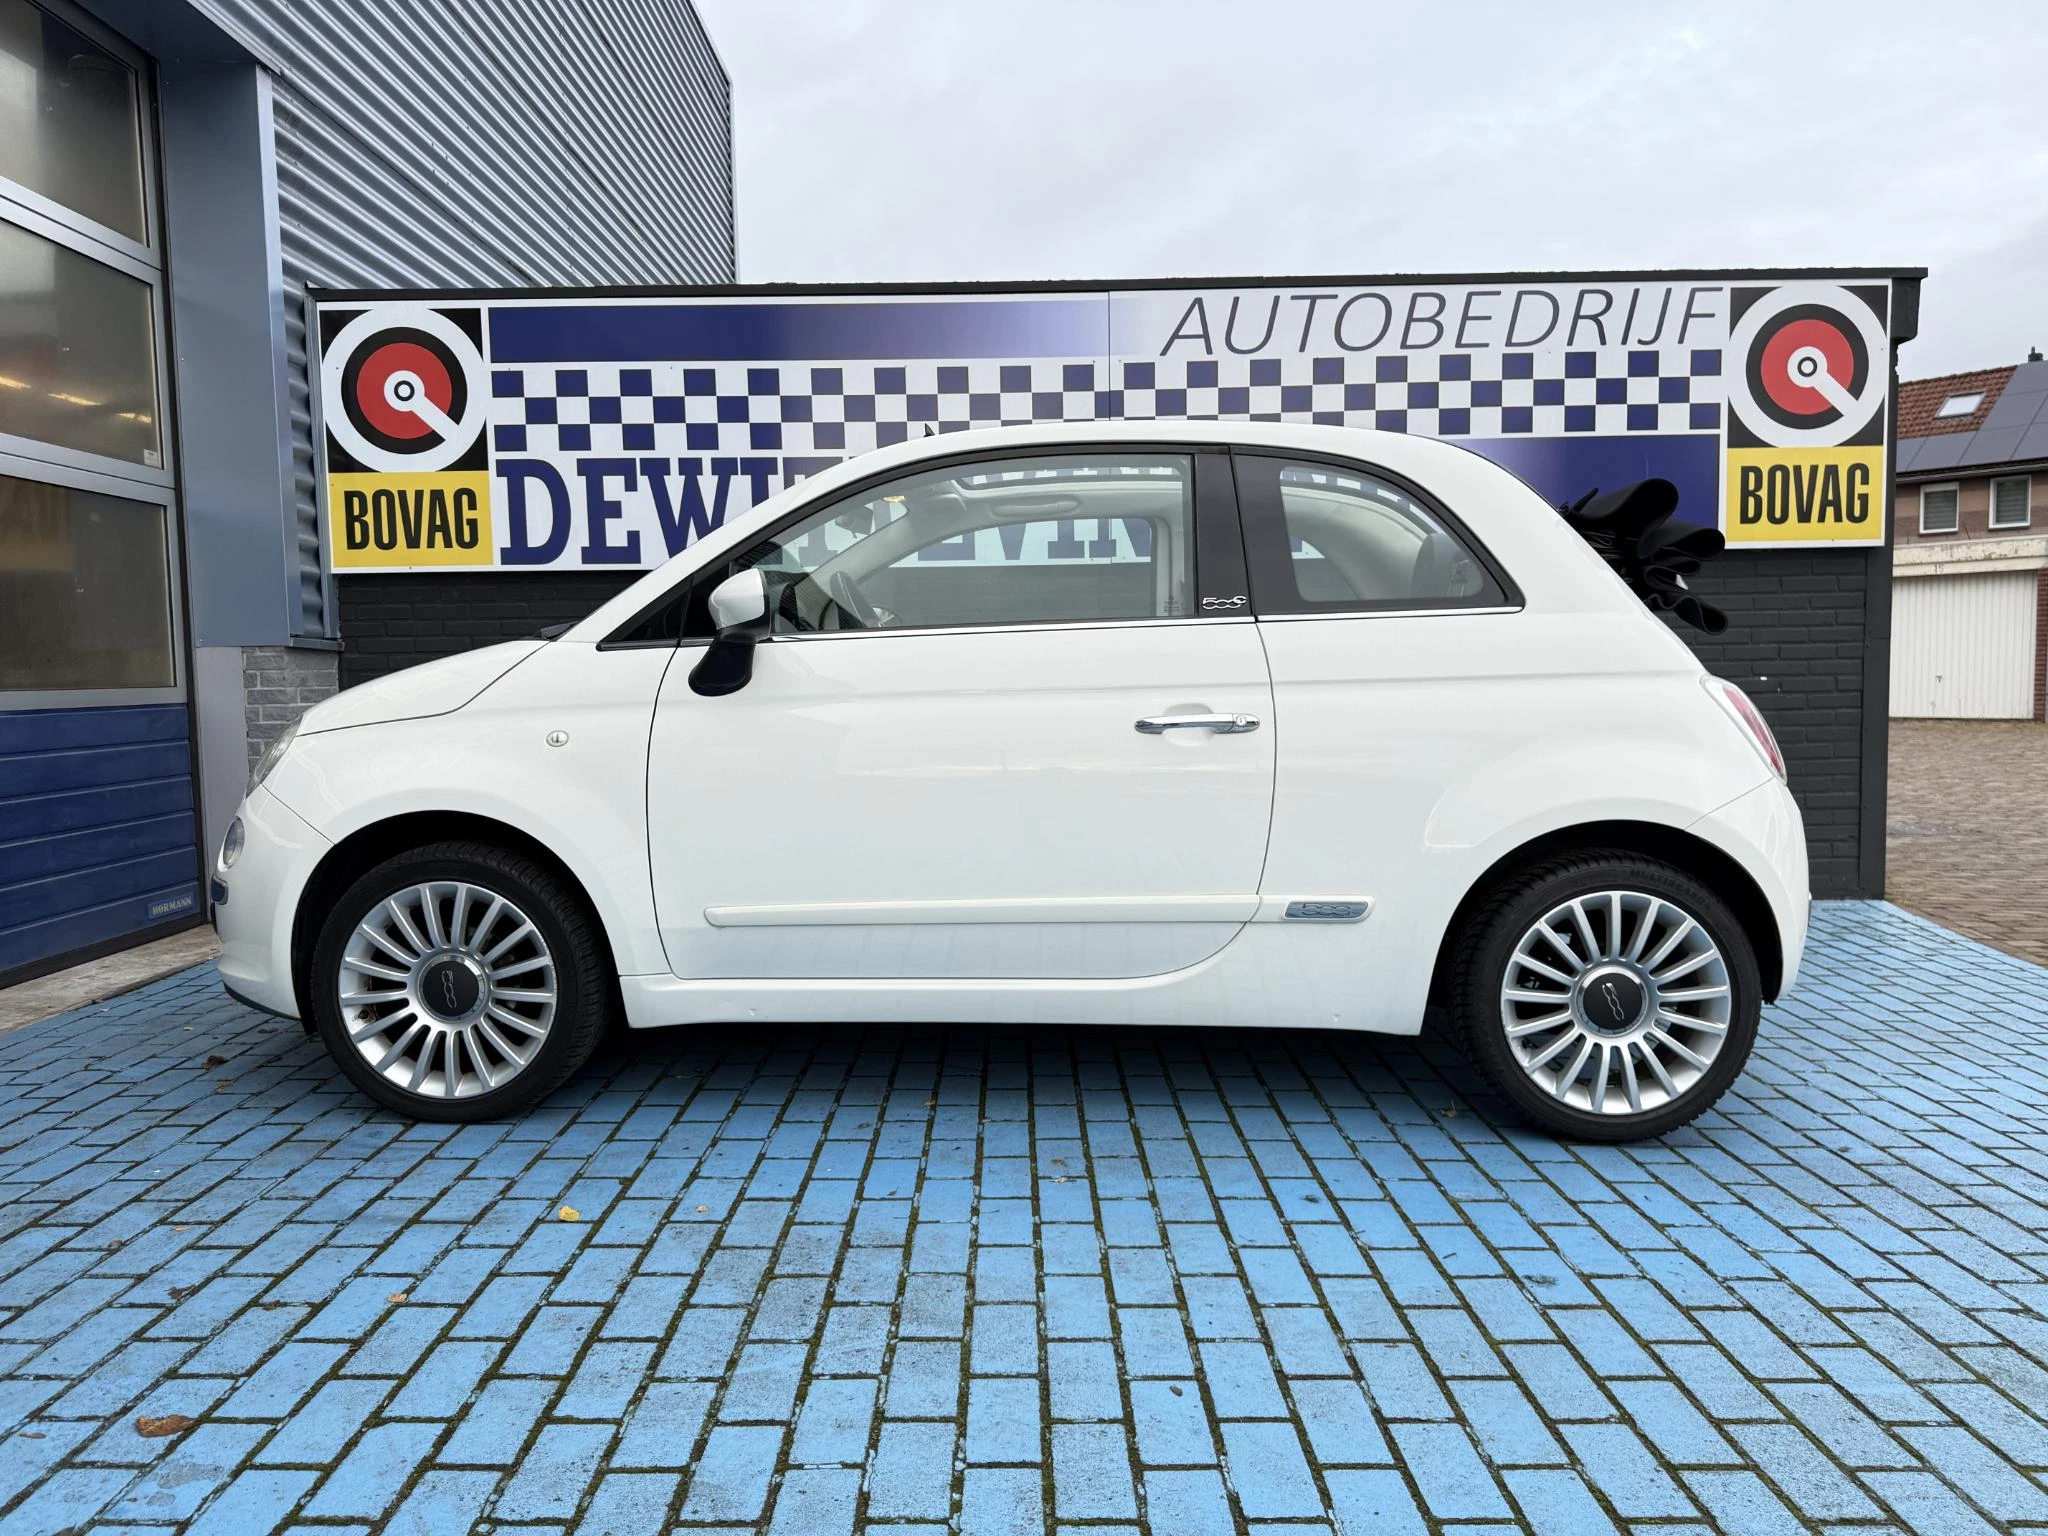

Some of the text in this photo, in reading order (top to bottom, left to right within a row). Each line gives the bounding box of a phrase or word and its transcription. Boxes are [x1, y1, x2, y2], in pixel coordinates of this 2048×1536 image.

[1159, 286, 1724, 356] AUTOBEDRIJF
[343, 487, 480, 551] BOVAG
[1739, 462, 1870, 525] BOVAG
[1301, 902, 1352, 916] 500
